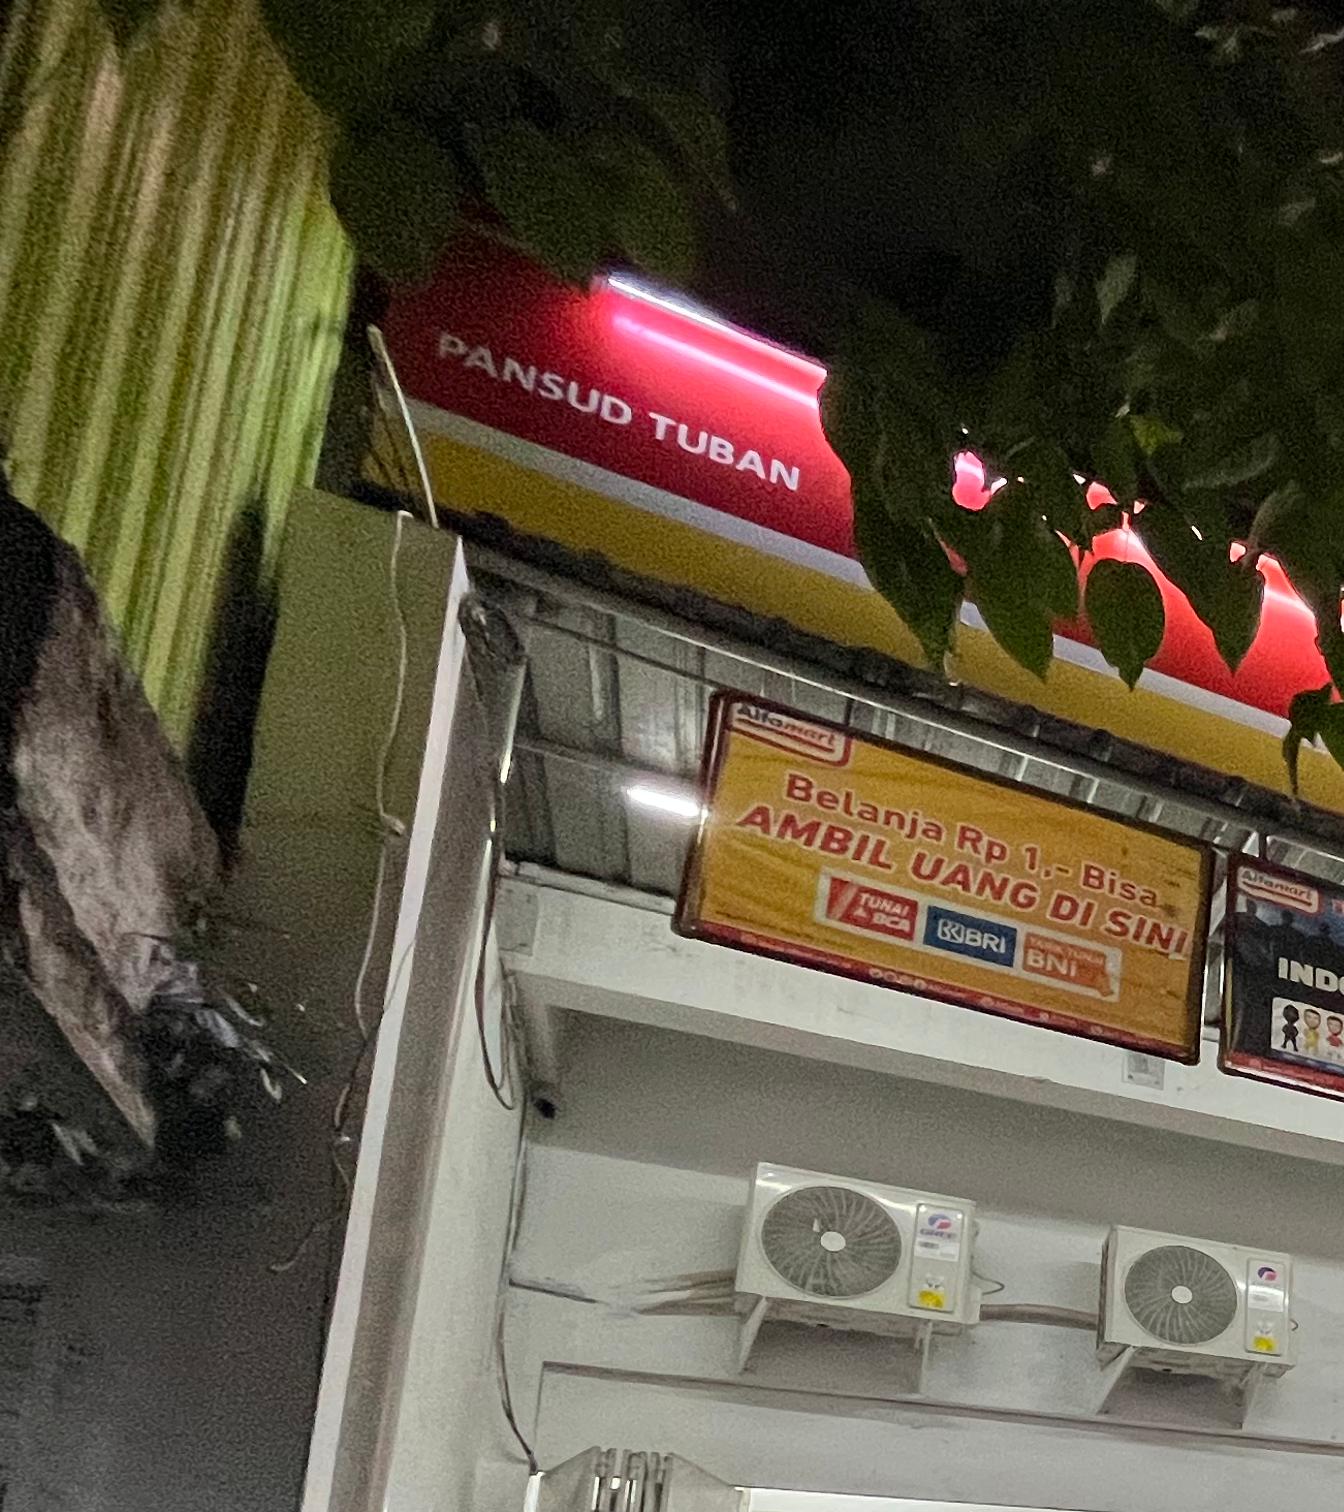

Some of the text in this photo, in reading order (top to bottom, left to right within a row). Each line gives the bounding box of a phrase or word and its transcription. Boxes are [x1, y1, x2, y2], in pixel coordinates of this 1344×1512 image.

[437, 333, 800, 491] PANSUD TUBAN
[737, 806, 1191, 957] AMBIL UANG DI SINI
[786, 773, 945, 842] Belanja
[957, 825, 1008, 865] Rp
[1082, 864, 1158, 908] Bisa
[859, 893, 912, 916] TUNAI
[963, 929, 1007, 955] BRI
[1027, 948, 1077, 977] BNI
